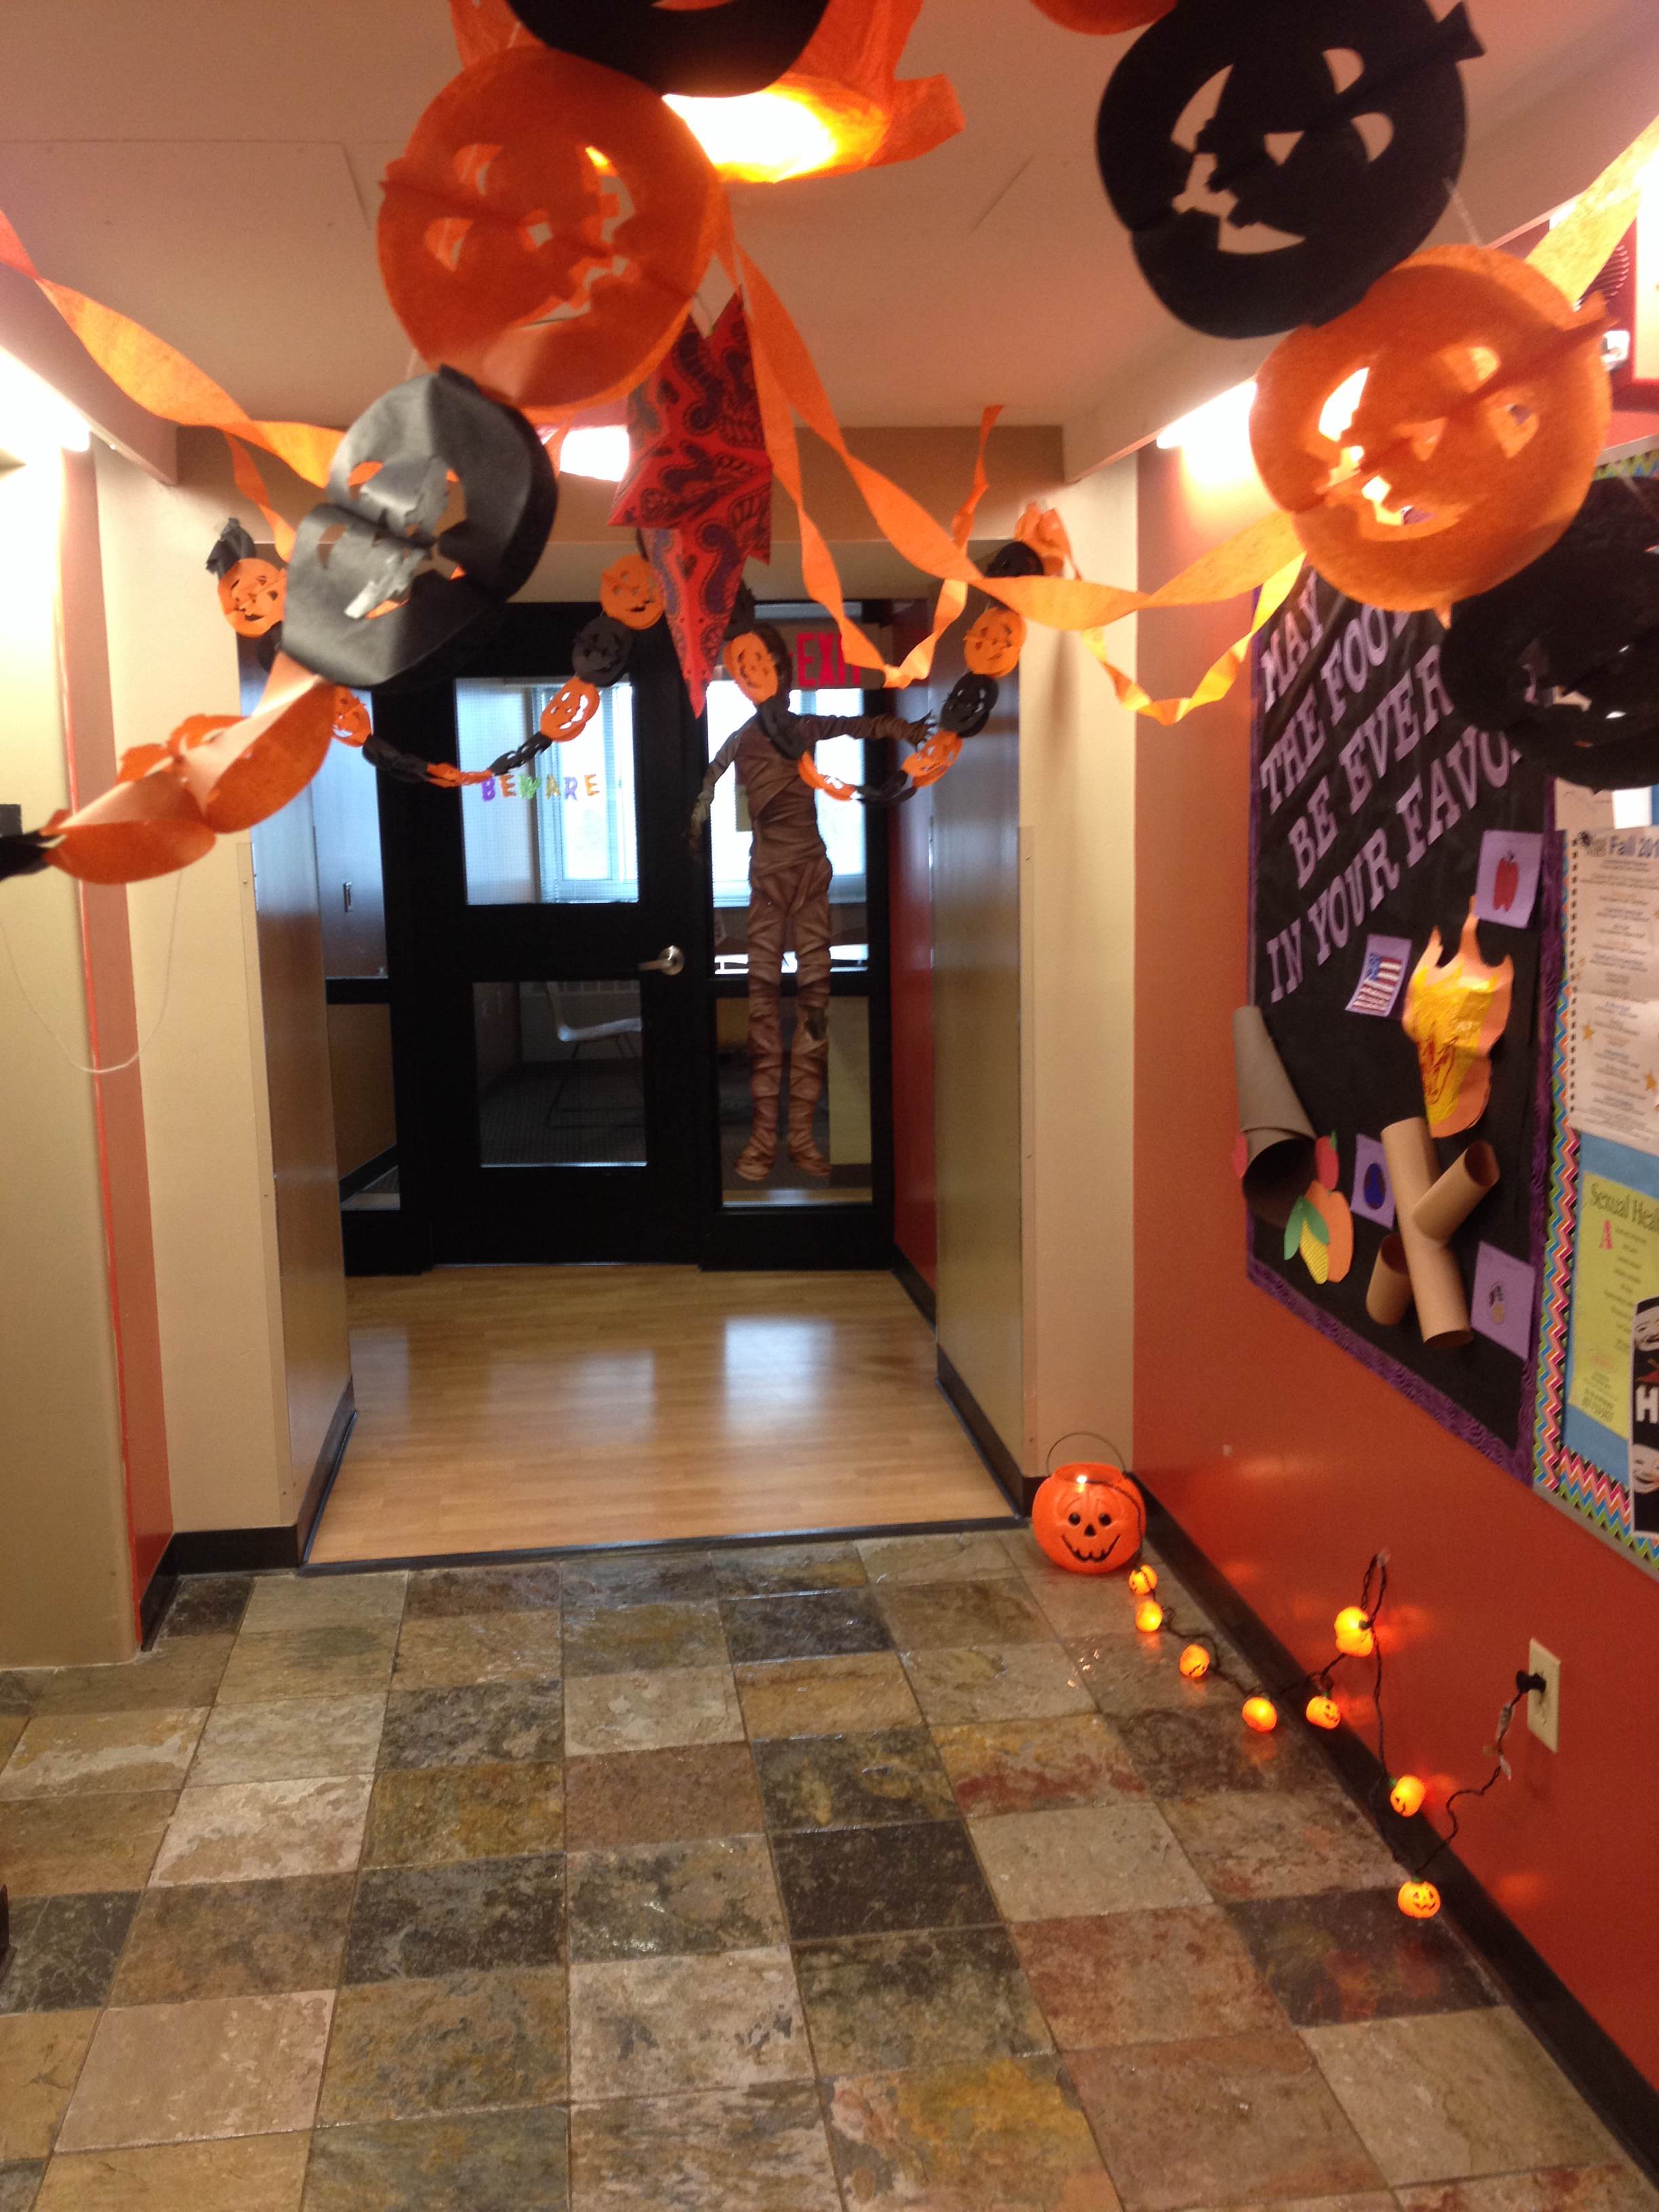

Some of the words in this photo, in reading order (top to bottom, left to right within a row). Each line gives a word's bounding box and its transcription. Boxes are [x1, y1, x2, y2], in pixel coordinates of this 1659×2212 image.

[797, 632, 861, 687] EXI
[1260, 680, 1326, 814] THE
[1321, 602, 1412, 726] FOO
[1261, 570, 1324, 713] MAY
[481, 774, 600, 802] BEWARE
[1288, 775, 1339, 889] BE
[1338, 644, 1454, 815] EVER
[1267, 918, 1303, 1004] IN
[1308, 827, 1401, 966] YOUR
[1396, 724, 1523, 868] FAVO
